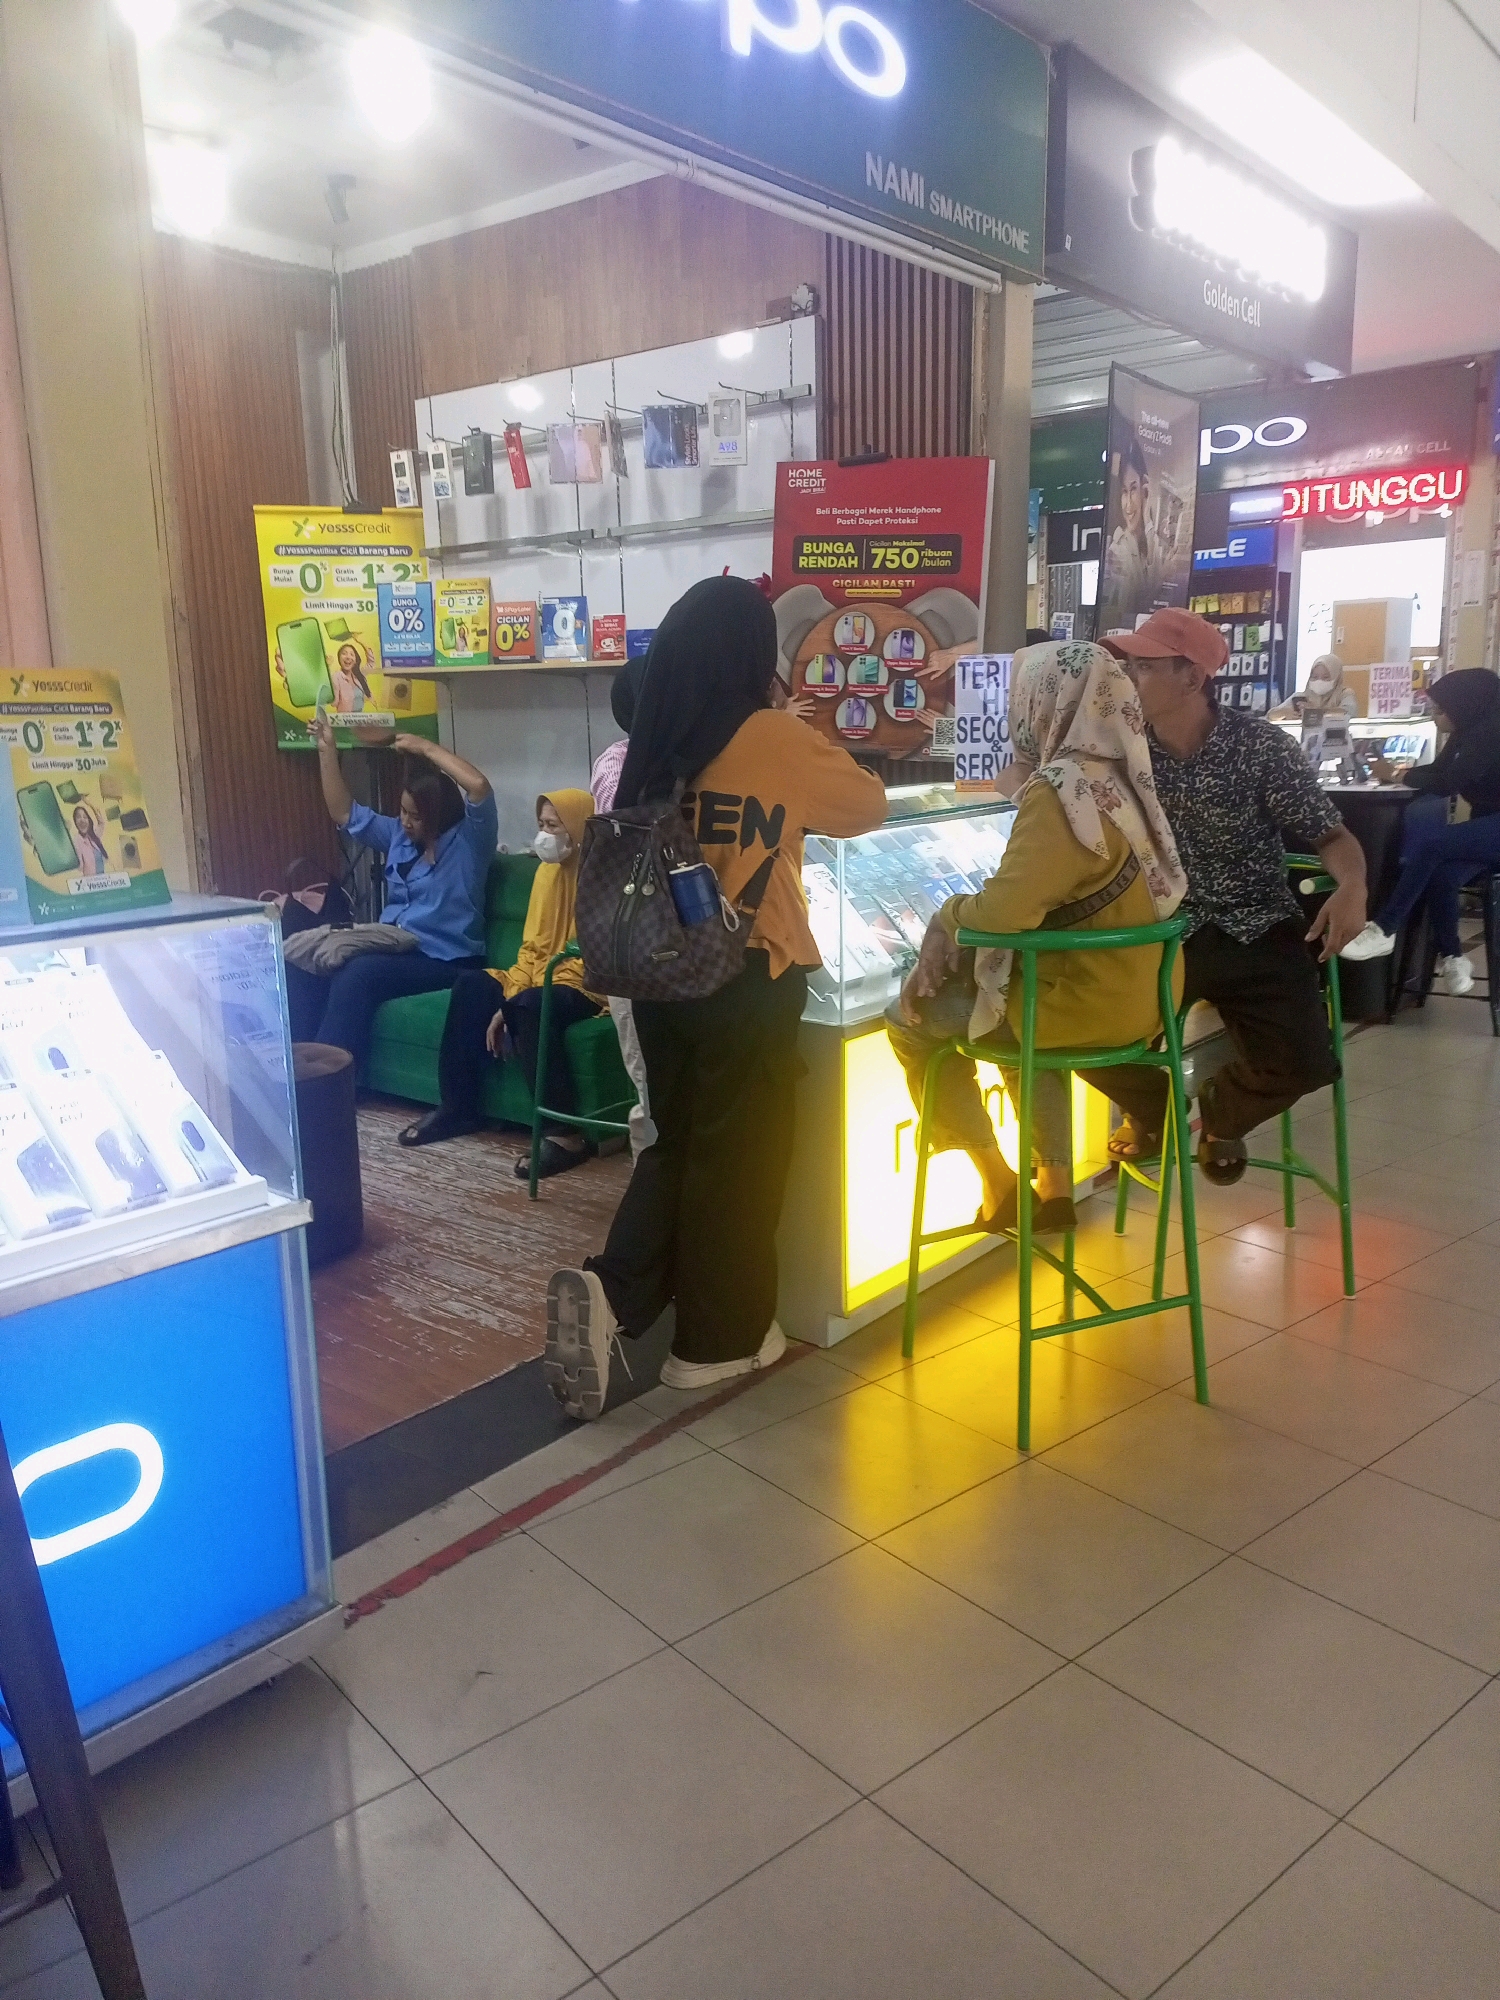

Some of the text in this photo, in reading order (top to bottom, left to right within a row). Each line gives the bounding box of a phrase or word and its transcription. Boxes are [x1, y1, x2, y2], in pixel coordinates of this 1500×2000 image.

[727, 0, 907, 98] po
[866, 151, 1030, 254] NAMI SMARTPHONE
[1203, 279, 1261, 328] Golden Cell
[1199, 416, 1308, 466] po
[788, 468, 823, 478] HOME
[788, 478, 827, 488] CREDIT
[1282, 469, 1463, 516] DITUNGGU
[816, 507, 831, 515] Beli
[832, 507, 867, 517] Berbagai
[895, 506, 942, 516] Handphone
[836, 516, 919, 527] Pasti Dapet Proteksi
[340, 546, 358, 555] Cicil
[359, 546, 388, 557] Barang
[389, 546, 408, 555] Baru
[802, 542, 855, 554] BUNGA
[921, 549, 953, 558] ribuan
[798, 556, 859, 569] RENDAH
[871, 548, 920, 569] 750
[921, 558, 952, 568] /bulan
[832, 579, 916, 589] CICILAN PASTI
[326, 602, 353, 611] Hingga
[356, 600, 374, 612] 30
[392, 598, 418, 607] BUNGA
[388, 608, 425, 632] 0%
[496, 616, 530, 624] CICILAN
[495, 623, 531, 652] 0%
[957, 660, 1013, 690] TERI
[1373, 666, 1411, 681] TERIMA
[1370, 681, 1411, 699] SERVICE
[70, 704, 93, 715] Barang
[94, 704, 110, 713] Baru
[1377, 699, 1401, 714] HP
[956, 715, 1010, 744] SECO
[990, 739, 1003, 752] &
[32, 758, 106, 771] Limit Hingga 30 Juta
[681, 790, 786, 850] EN
